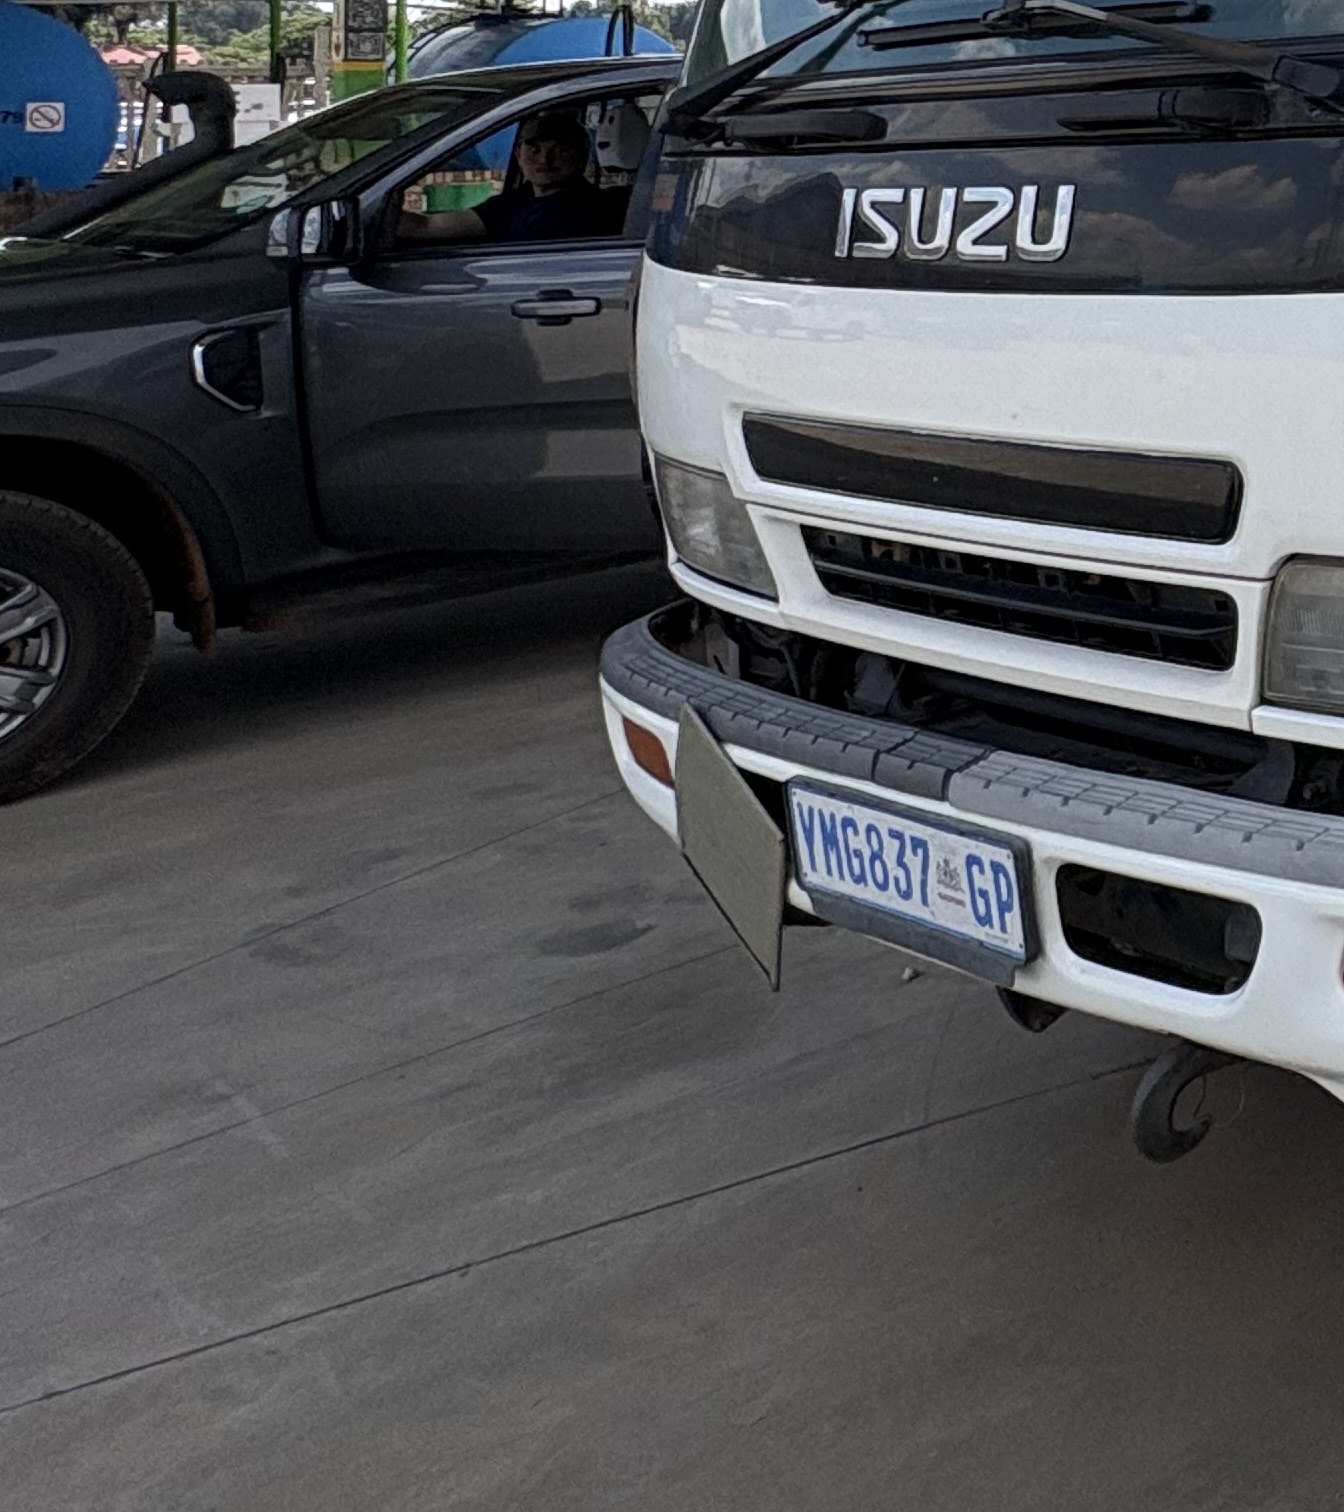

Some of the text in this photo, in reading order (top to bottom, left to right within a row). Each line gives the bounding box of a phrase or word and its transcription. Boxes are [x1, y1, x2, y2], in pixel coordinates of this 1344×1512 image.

[834, 183, 1077, 263] ISUZU
[796, 801, 1014, 934] YMG837 GP
